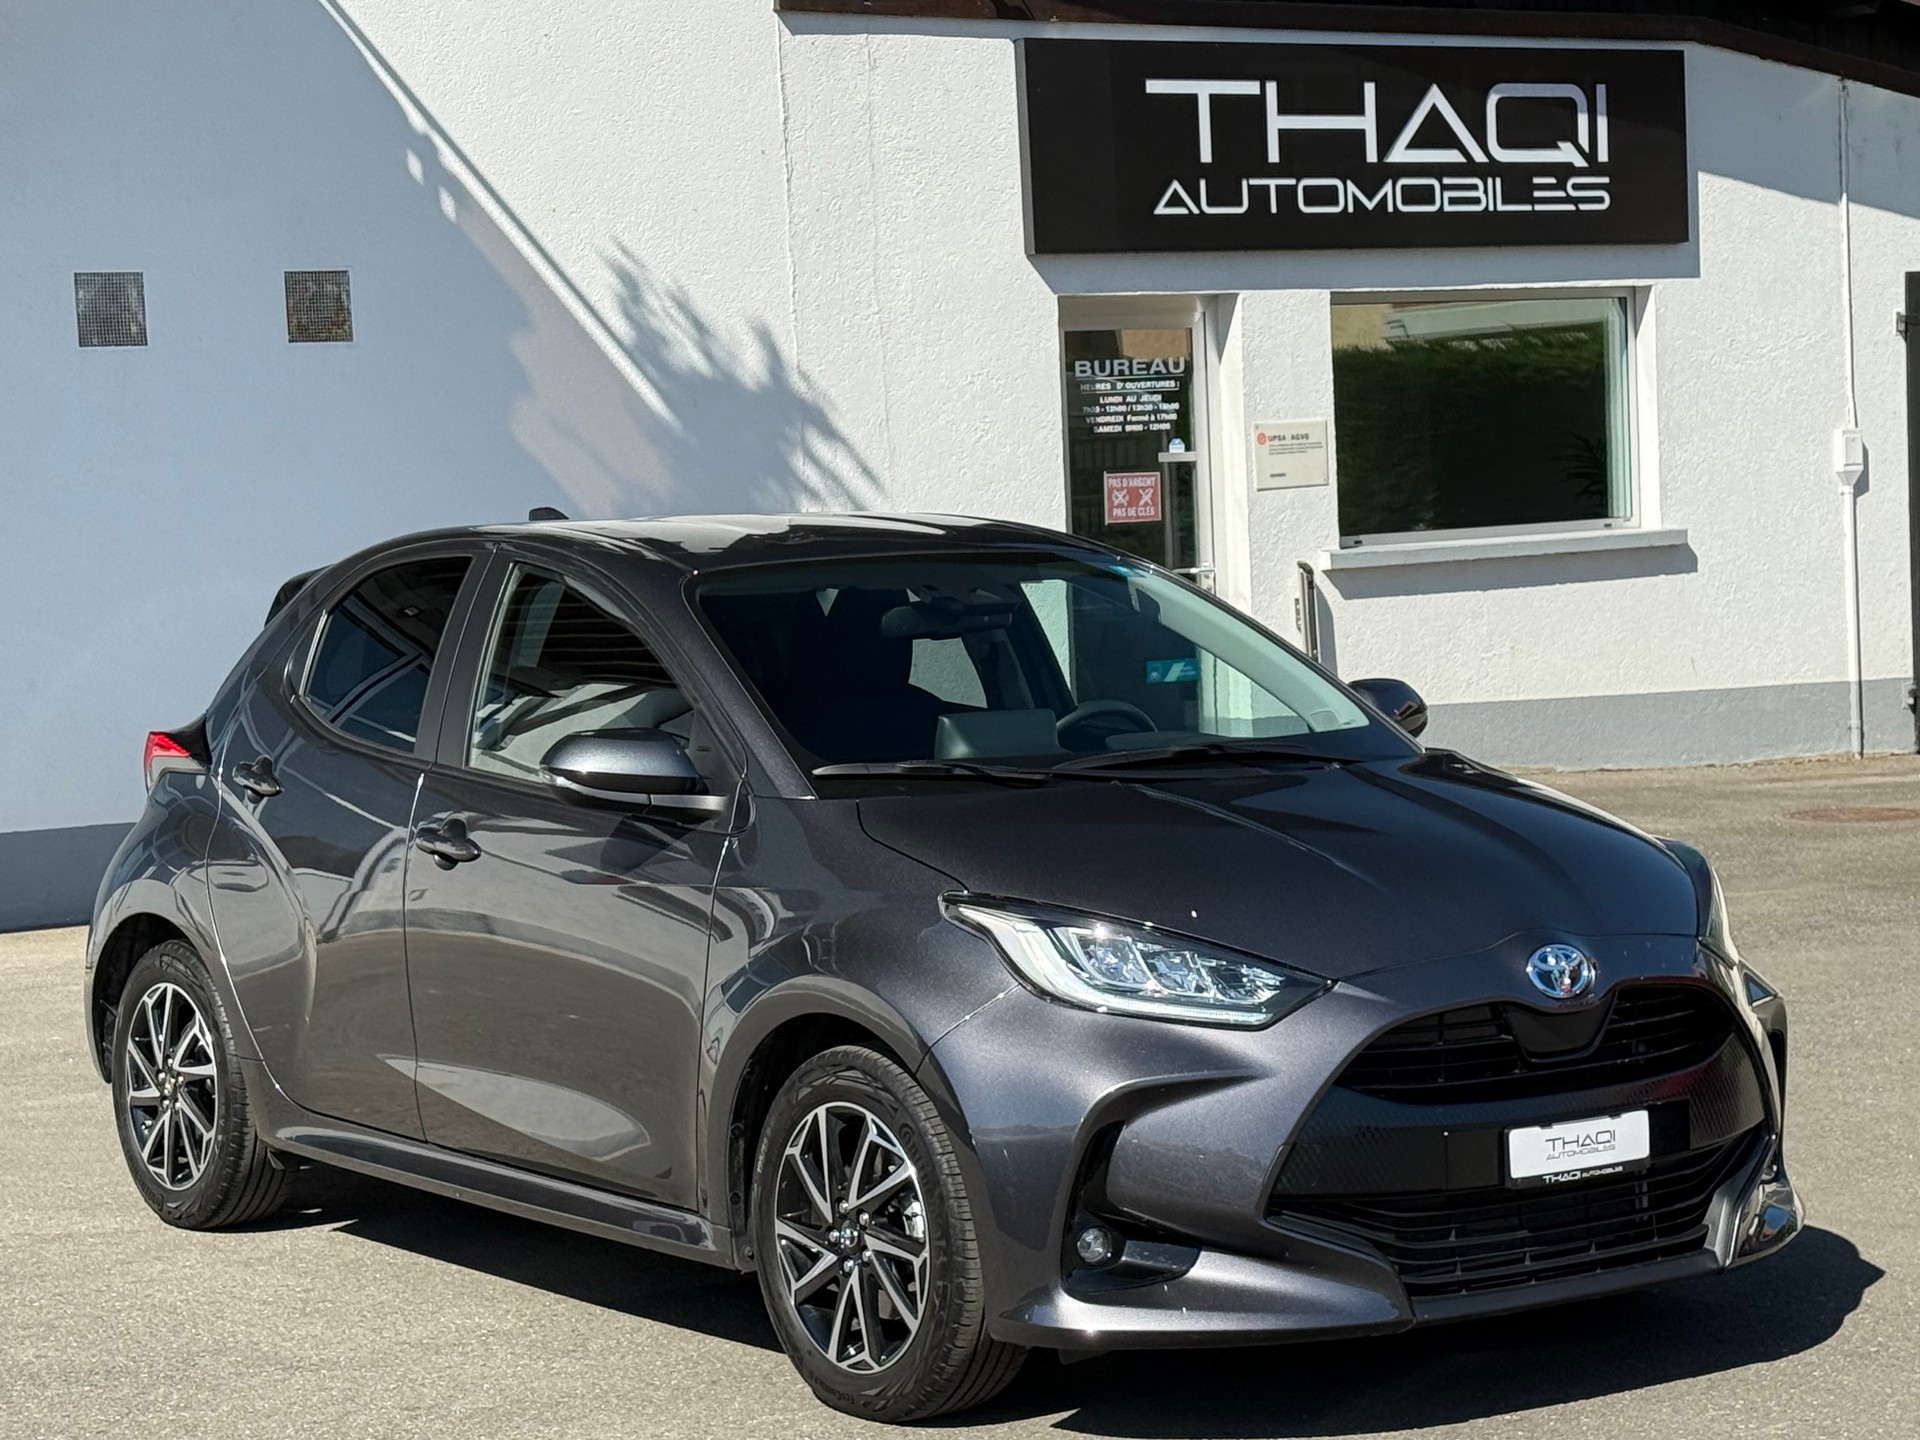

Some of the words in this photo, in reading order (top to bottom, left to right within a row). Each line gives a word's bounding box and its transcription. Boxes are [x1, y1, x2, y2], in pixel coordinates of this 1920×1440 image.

[1145, 78, 1609, 167] THAQI
[1153, 175, 1610, 215] AUTOMOBILES
[1074, 357, 1185, 377] BUREAU
[1080, 382, 1111, 391] HEURES
[1099, 396, 1123, 404] LUNDI
[1139, 394, 1162, 402] JEUDI
[1086, 415, 1124, 424] VENDREDI
[1093, 425, 1122, 433] SAMEDI
[1268, 434, 1286, 442] UPSA
[1108, 478, 1121, 488] PAS
[1113, 508, 1126, 517] PAS
[1127, 507, 1137, 516] DE
[1545, 1129, 1616, 1152] THAQI
[1545, 1144, 1616, 1161] AUTOMOBILES
[1542, 1171, 1580, 1184] THAQI
